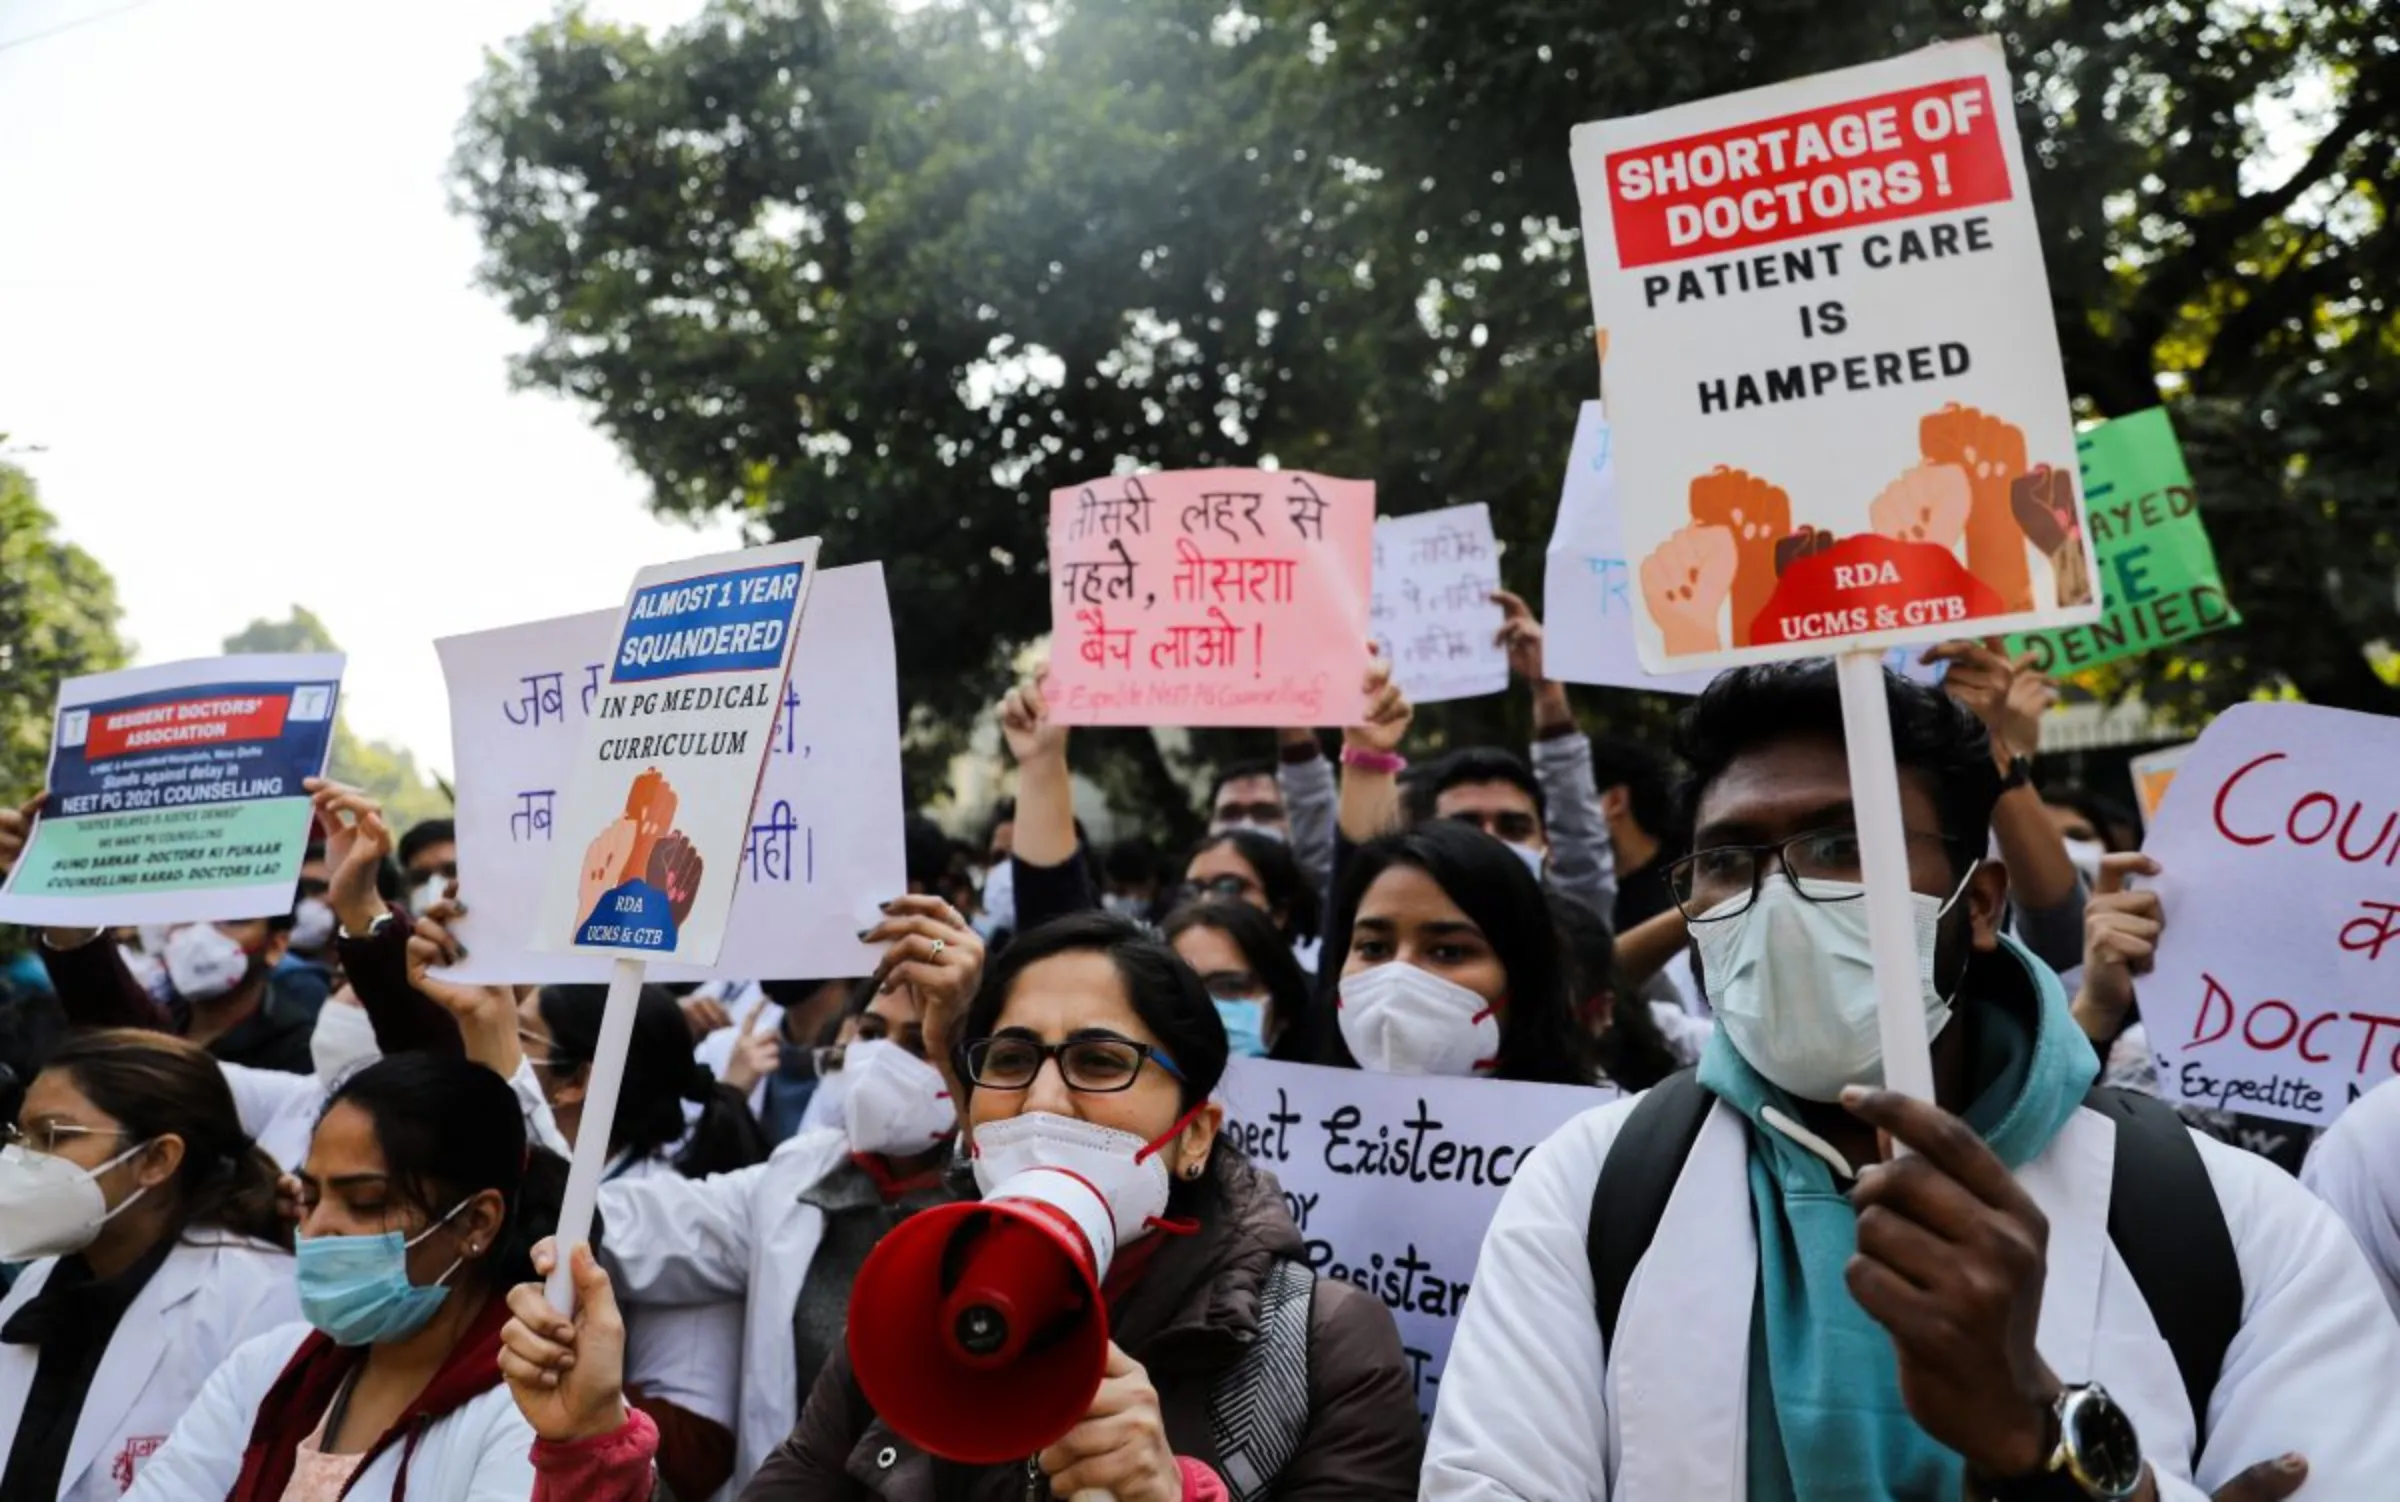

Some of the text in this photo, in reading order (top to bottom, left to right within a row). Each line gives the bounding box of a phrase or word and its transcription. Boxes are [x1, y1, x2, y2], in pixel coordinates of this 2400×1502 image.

[1617, 88, 1983, 201] SHORTAGE OF
[1643, 216, 1994, 308] PATIENT CARE
[1799, 301, 1848, 338] IS
[1698, 341, 1971, 414] HAMPERED
[1180, 492, 1265, 543] लहर
[1286, 476, 1330, 541] से
[2090, 485, 2199, 542] AYED
[631, 573, 799, 620] ALMOST 1 YEAR
[1832, 559, 1902, 591] RDA
[1779, 595, 1967, 641] UCMS & GTB
[2024, 586, 2229, 671] DENIED
[621, 619, 783, 667] SQUANDERED
[107, 707, 174, 731] RESIDENT
[503, 664, 605, 727] जब त
[600, 683, 769, 719] IN PG MEDICAL
[125, 722, 227, 748] ASSOCIATION
[599, 731, 748, 761] CURRICULUM
[62, 777, 283, 815] NEET PG 2021 COUNSELLING
[102, 763, 240, 789] Stands against delay in
[511, 789, 557, 842] तब
[46, 871, 138, 888] COUNSELLING
[188, 864, 252, 881] DOCTORS
[91, 853, 141, 869] SARKAR
[226, 841, 283, 857] PUKAAR
[587, 895, 663, 945] RDA UCMS & GTB
[2180, 1061, 2324, 1114] Expedite
[1229, 1087, 1302, 1162] pect
